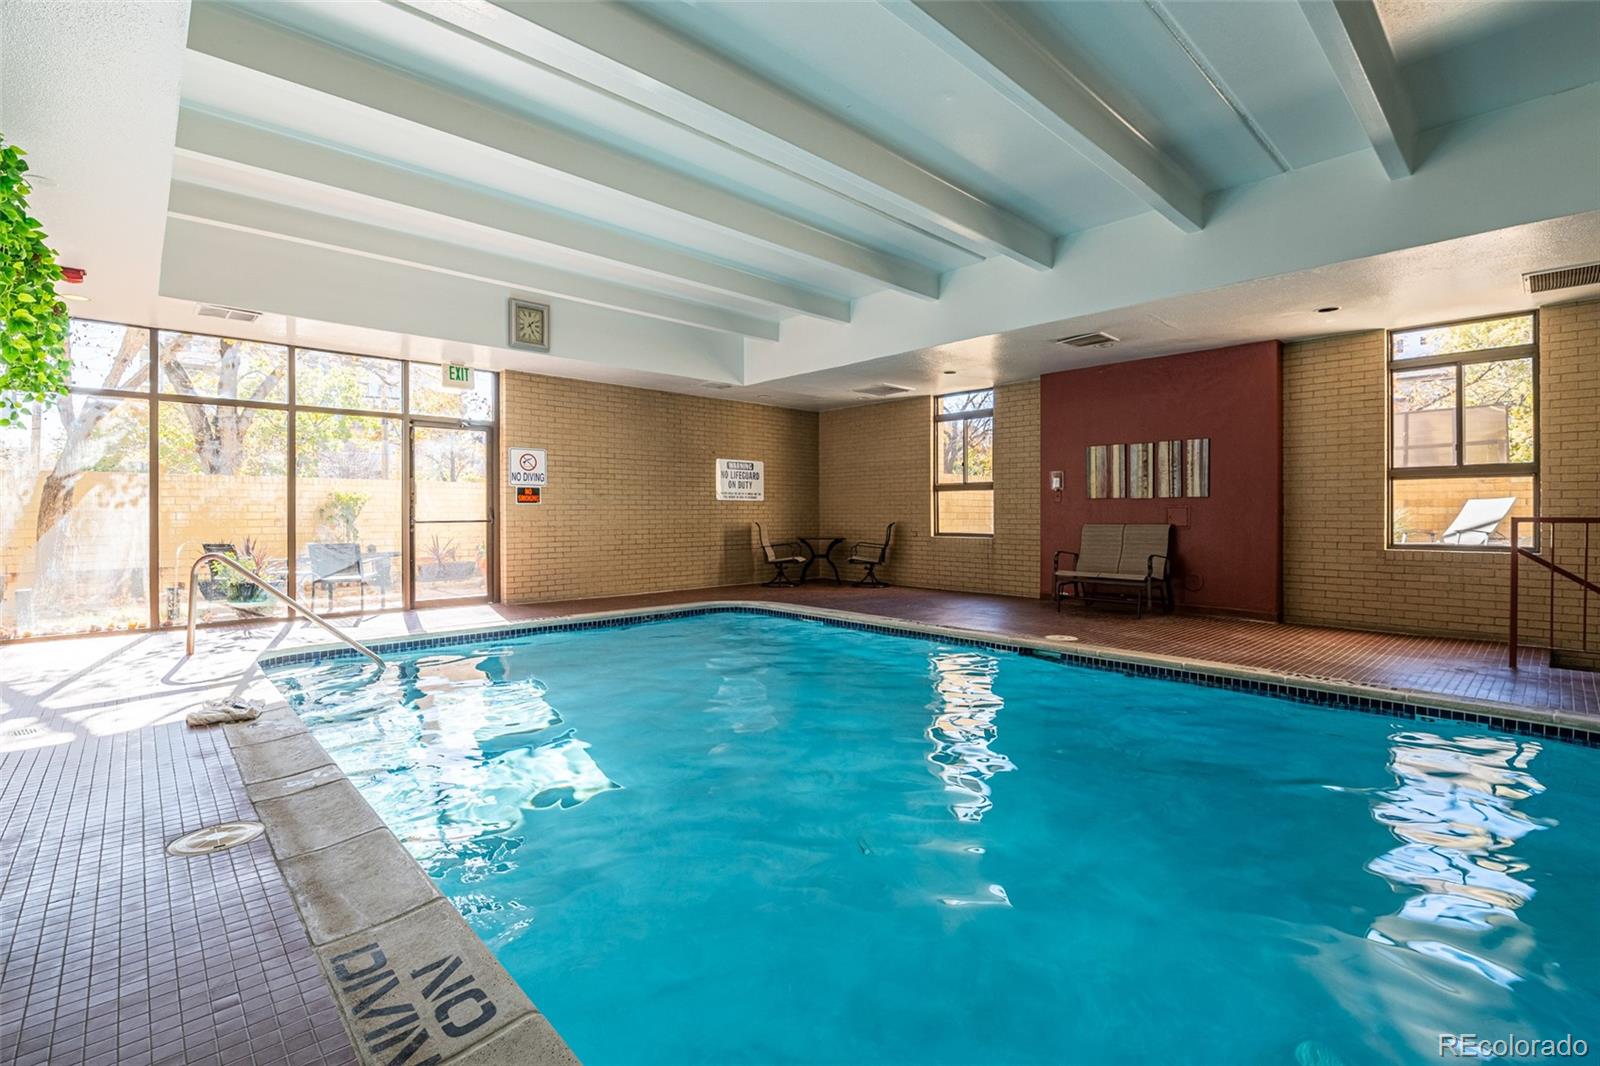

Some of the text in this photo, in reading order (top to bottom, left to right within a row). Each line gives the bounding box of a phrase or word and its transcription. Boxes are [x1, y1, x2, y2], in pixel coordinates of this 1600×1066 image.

[449, 366, 470, 382] EXIT
[511, 472, 545, 482] NO DIVING
[720, 470, 760, 480] NO LIFEGUARD
[728, 480, 753, 490] ON DUTY
[409, 955, 498, 1038] NO
